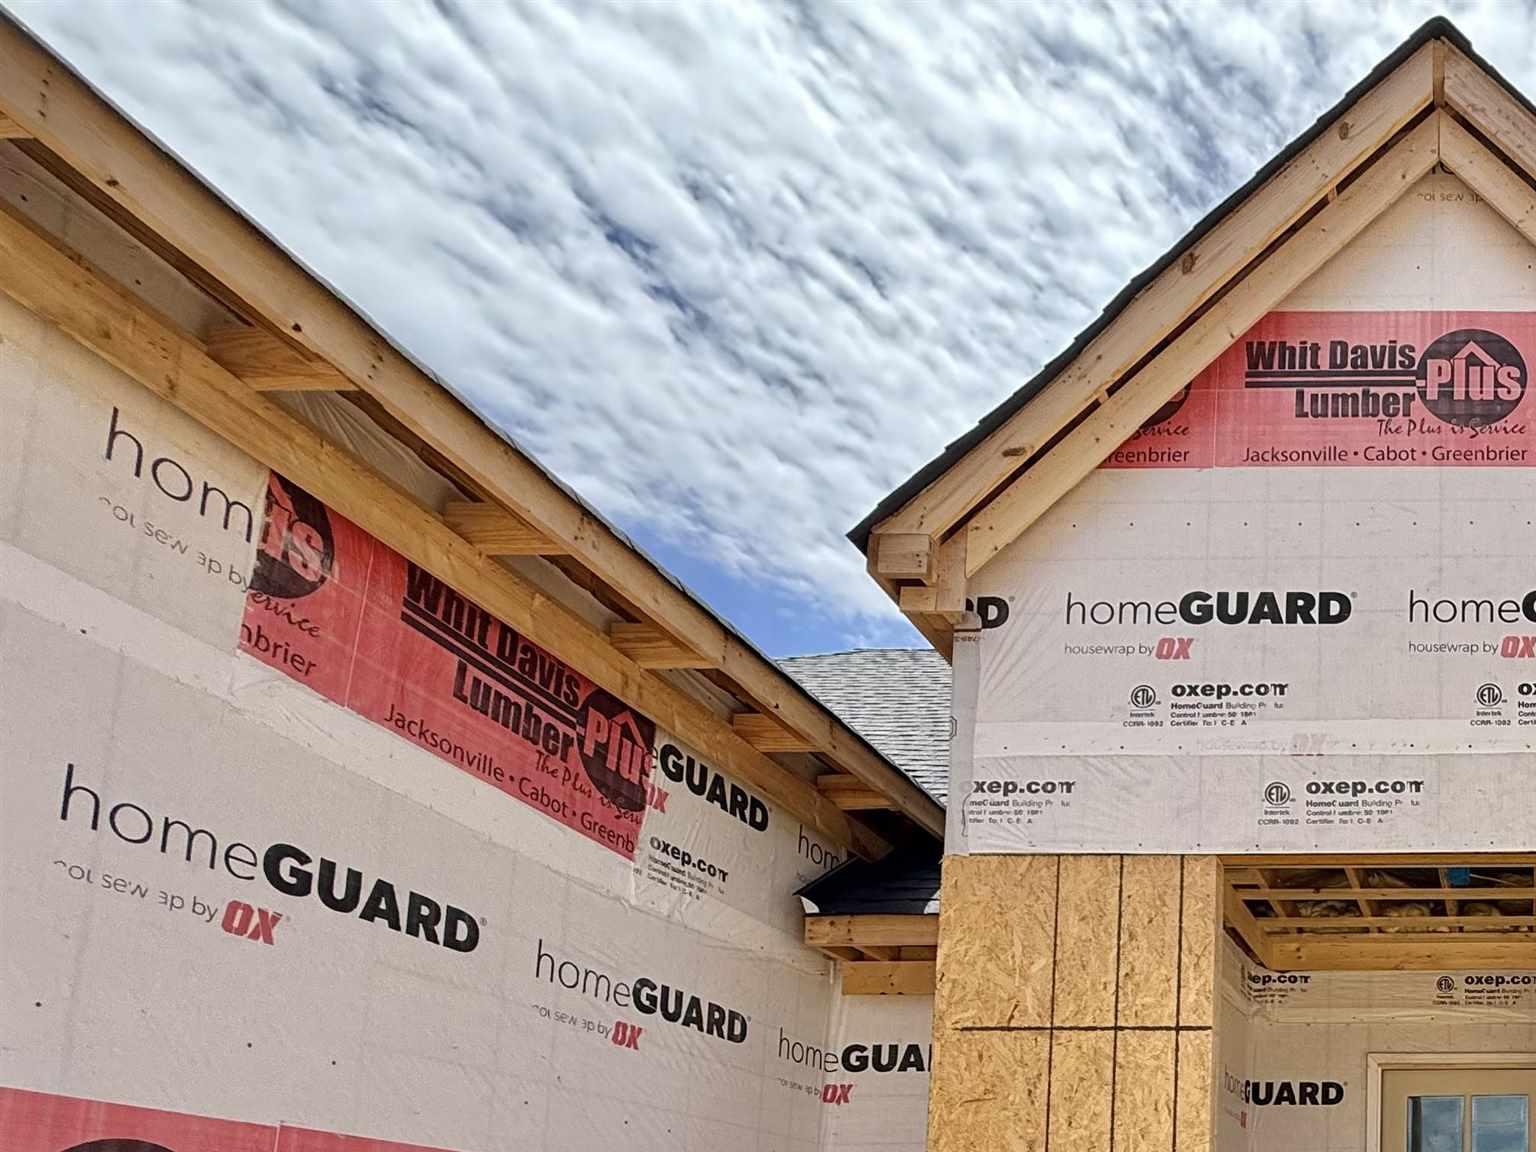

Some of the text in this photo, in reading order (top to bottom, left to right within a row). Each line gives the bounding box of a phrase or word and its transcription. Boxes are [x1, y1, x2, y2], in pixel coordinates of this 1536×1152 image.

[1245, 338, 1416, 370] Whit Davis
[1427, 357, 1522, 402] Plus
[1294, 388, 1416, 419] Lumber
[1377, 418, 1528, 439] The Plus is Service
[1104, 448, 1190, 463] reenbrier
[1242, 445, 1528, 464] Jacksonville Cabot Greenbrier
[1066, 590, 1354, 626] homeGUARD
[497, 618, 582, 709] Davis
[1063, 637, 1196, 661] housewrap by OX
[1407, 640, 1479, 657] housewrap
[1482, 640, 1499, 657] by
[452, 658, 576, 763] Lumber
[383, 703, 635, 854] Jacksonville Cabot Greenb
[535, 749, 593, 799] The Plus
[60, 762, 483, 954] homeGUARD
[192, 897, 286, 946] by OX
[534, 938, 750, 1046] homeGUARD
[596, 1021, 646, 1052] by OX
[778, 1027, 932, 1073] homeGUA
[820, 1083, 854, 1106] OX
